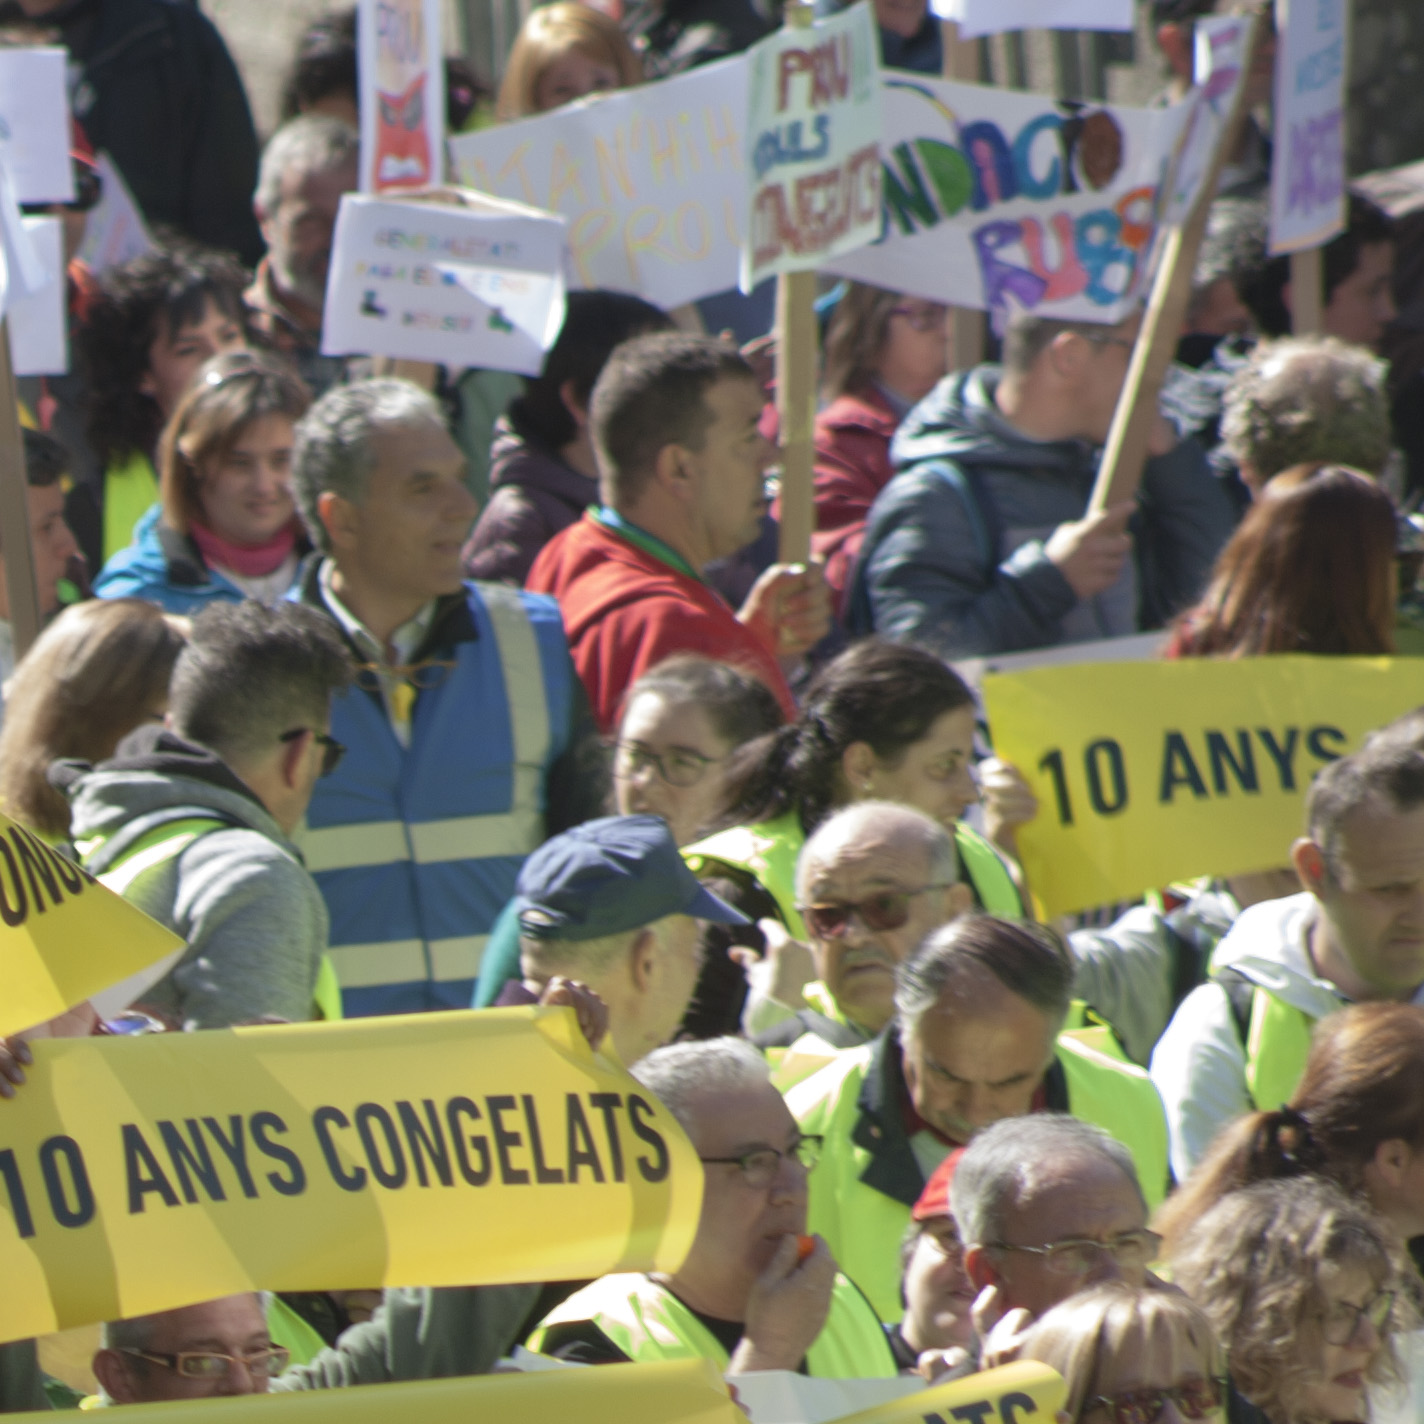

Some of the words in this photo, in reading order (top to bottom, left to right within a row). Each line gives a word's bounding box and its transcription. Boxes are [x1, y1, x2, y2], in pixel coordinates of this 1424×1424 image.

[1038, 734, 1131, 829] 10
[1158, 722, 1349, 806] ANYS
[120, 1109, 307, 1215] ANYS
[313, 1090, 672, 1193] CONGELATS
